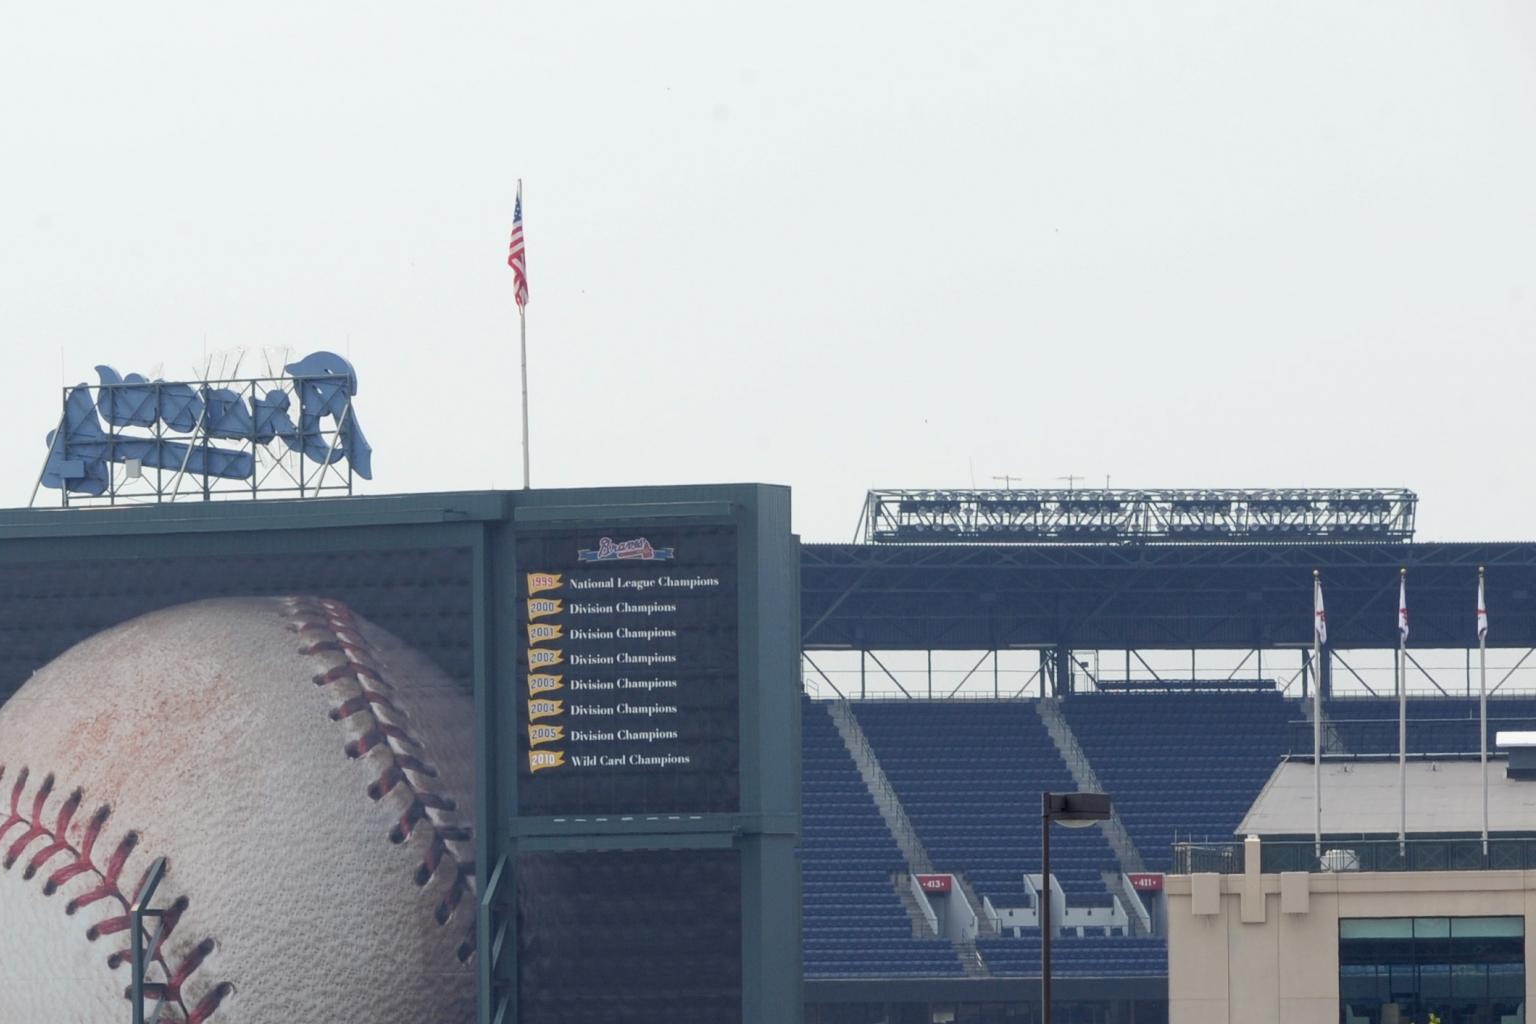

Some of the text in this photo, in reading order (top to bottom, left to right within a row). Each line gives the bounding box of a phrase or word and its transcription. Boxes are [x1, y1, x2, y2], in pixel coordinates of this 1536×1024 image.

[532, 576, 719, 590] 1999 National League Champions
[531, 602, 676, 615] 2000 Division Champions
[531, 627, 676, 640] 2001 Division Champions
[531, 653, 676, 665] 2002 Division Champions
[531, 678, 677, 691] 2003 Division Champions
[530, 703, 677, 716] 2004 Division Champions
[532, 728, 677, 742] 2005 Division Champions
[531, 754, 690, 767] 2010 Wild Card Champions
